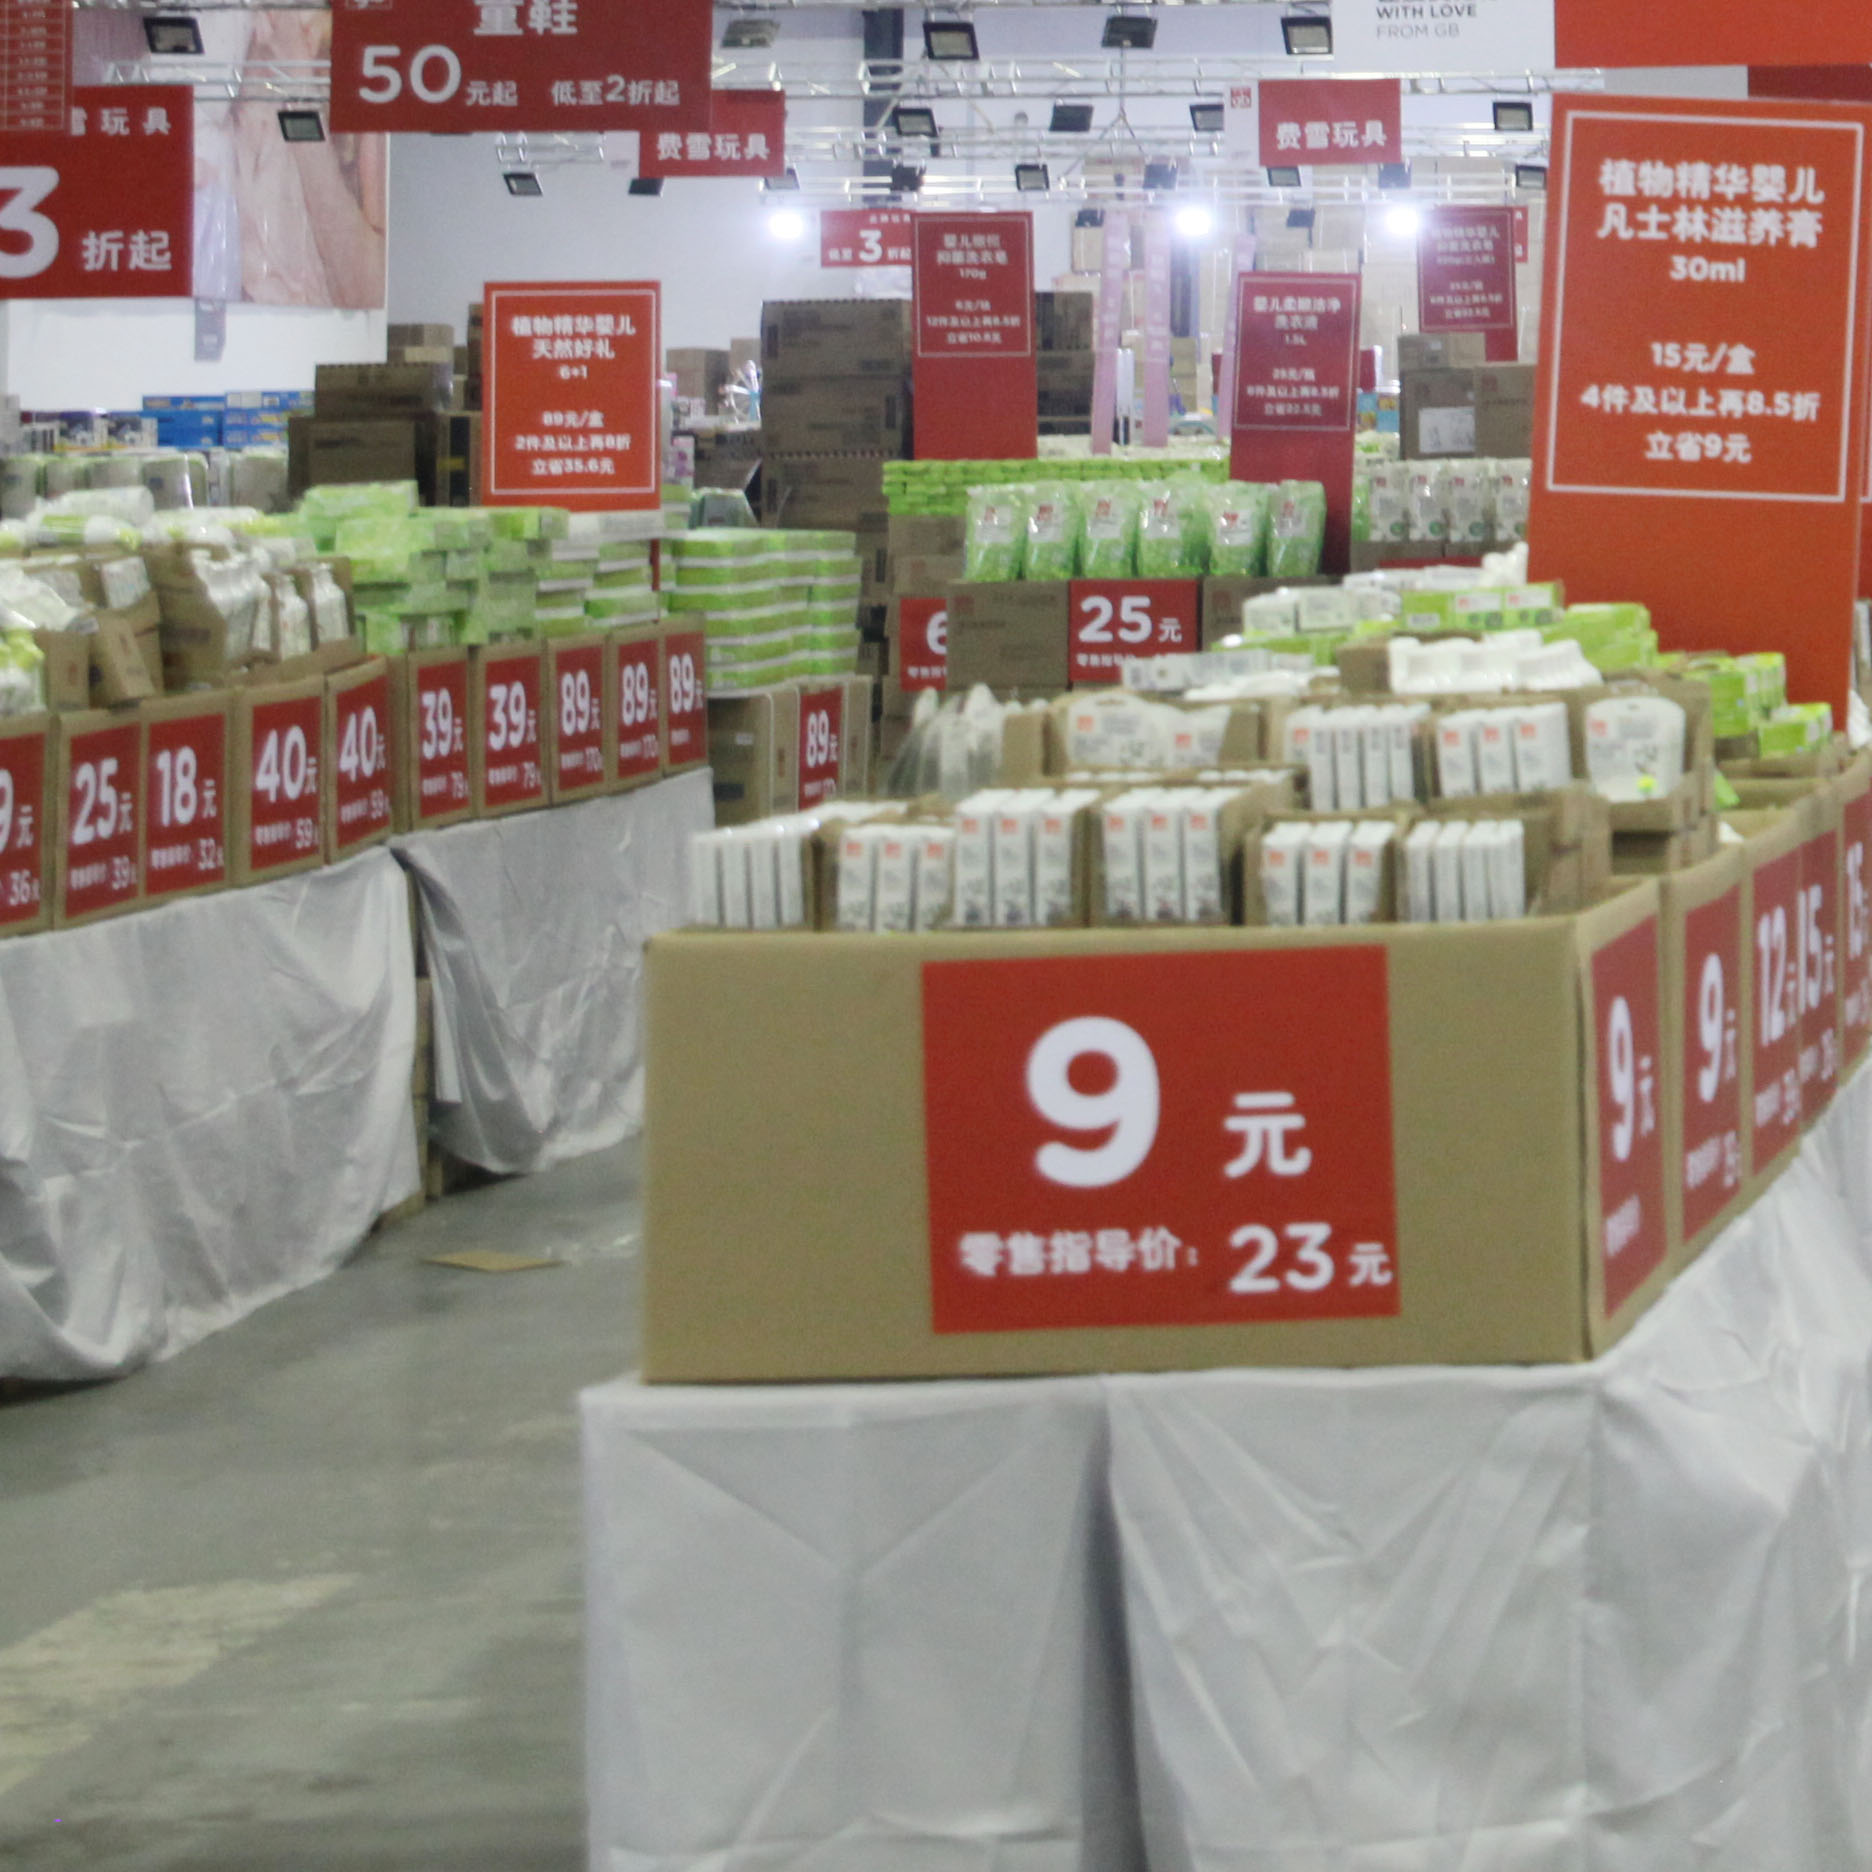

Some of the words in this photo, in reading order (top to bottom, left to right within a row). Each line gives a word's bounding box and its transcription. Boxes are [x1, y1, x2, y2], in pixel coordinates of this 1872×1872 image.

[1376, 4, 1424, 19] WITH
[1429, 3, 1475, 18] LOVE
[1376, 24, 1426, 39] FROM
[1433, 23, 1461, 38] GB
[359, 45, 517, 105] 50元起
[551, 75, 679, 105] 低至2折起
[658, 133, 770, 160] 费雪玩具
[1599, 159, 1824, 205] 植物精华婴儿
[1670, 255, 1745, 282] 30ml
[1651, 342, 1755, 374] 15元/盒
[1581, 384, 1819, 421] 4件及以上再8.5折
[1646, 431, 1751, 463] 立省9元
[1079, 596, 1182, 642] 25元
[1027, 1017, 1311, 1187] 9元
